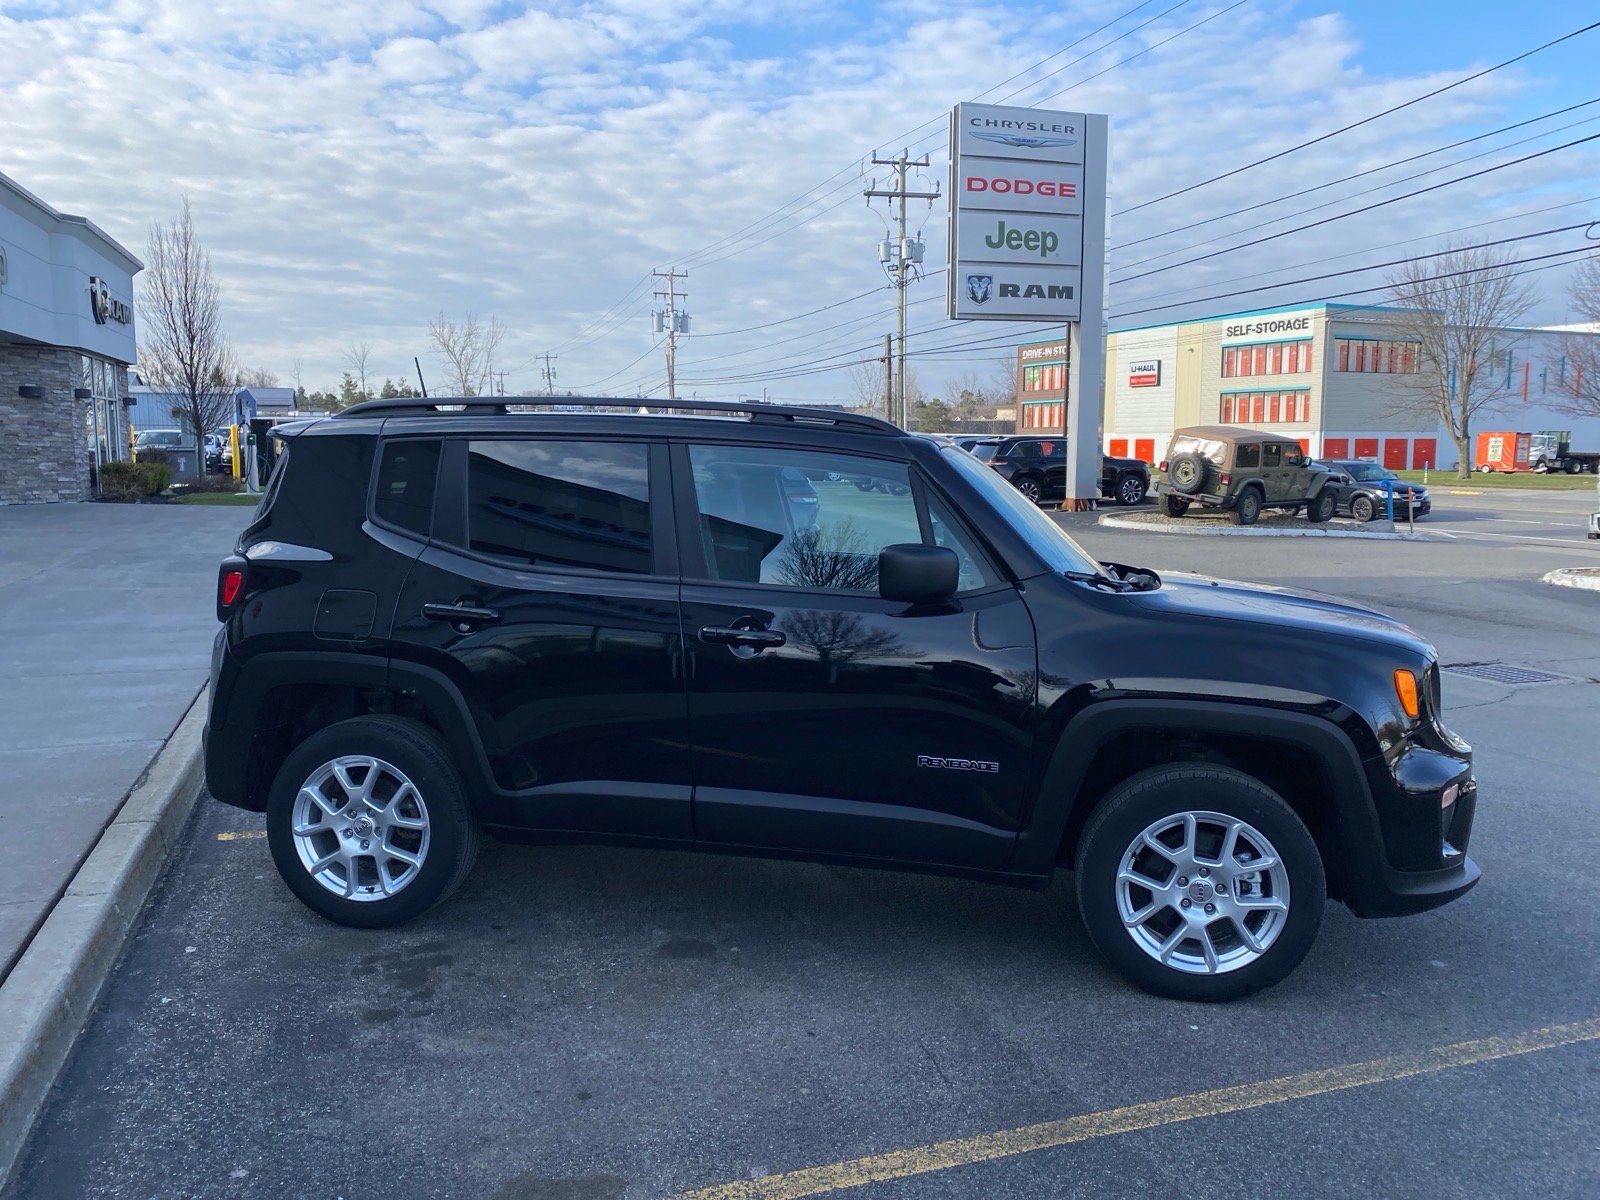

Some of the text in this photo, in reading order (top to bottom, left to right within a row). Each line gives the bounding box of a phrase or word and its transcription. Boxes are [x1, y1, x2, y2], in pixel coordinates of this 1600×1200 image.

[970, 118, 1075, 134] CHRYSLER
[967, 177, 1076, 198] DODGE
[985, 220, 1059, 257] Jeep
[999, 283, 1074, 300] RAM
[1226, 318, 1309, 337] SELF-STORAGE
[1022, 347, 1053, 359] DRIVE-IN
[1131, 364, 1156, 373] U-HAUL
[917, 755, 999, 772] RENEGADE
